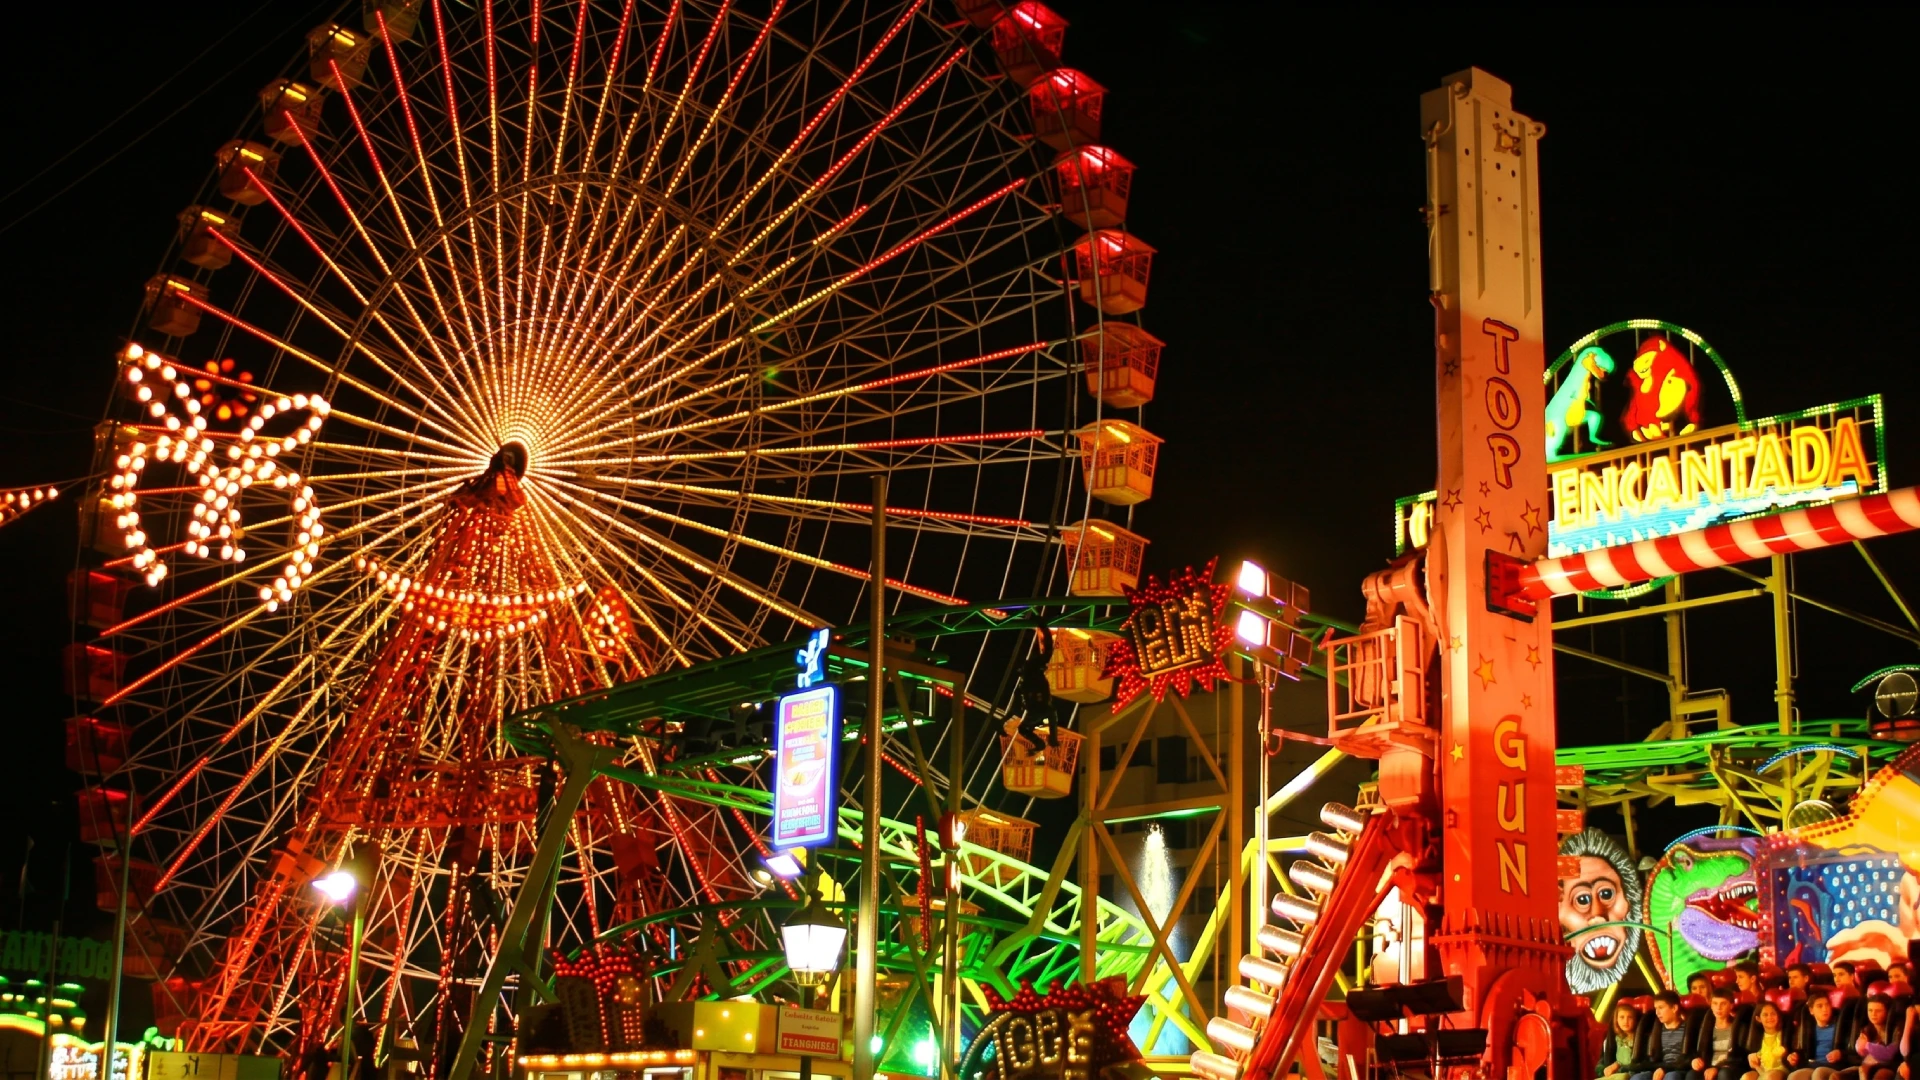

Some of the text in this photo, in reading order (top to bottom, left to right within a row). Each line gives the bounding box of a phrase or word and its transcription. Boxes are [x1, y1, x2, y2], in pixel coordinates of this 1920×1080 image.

[1483, 318, 1529, 897] TOP GUN
[1552, 416, 1871, 529] ENCANTADA
